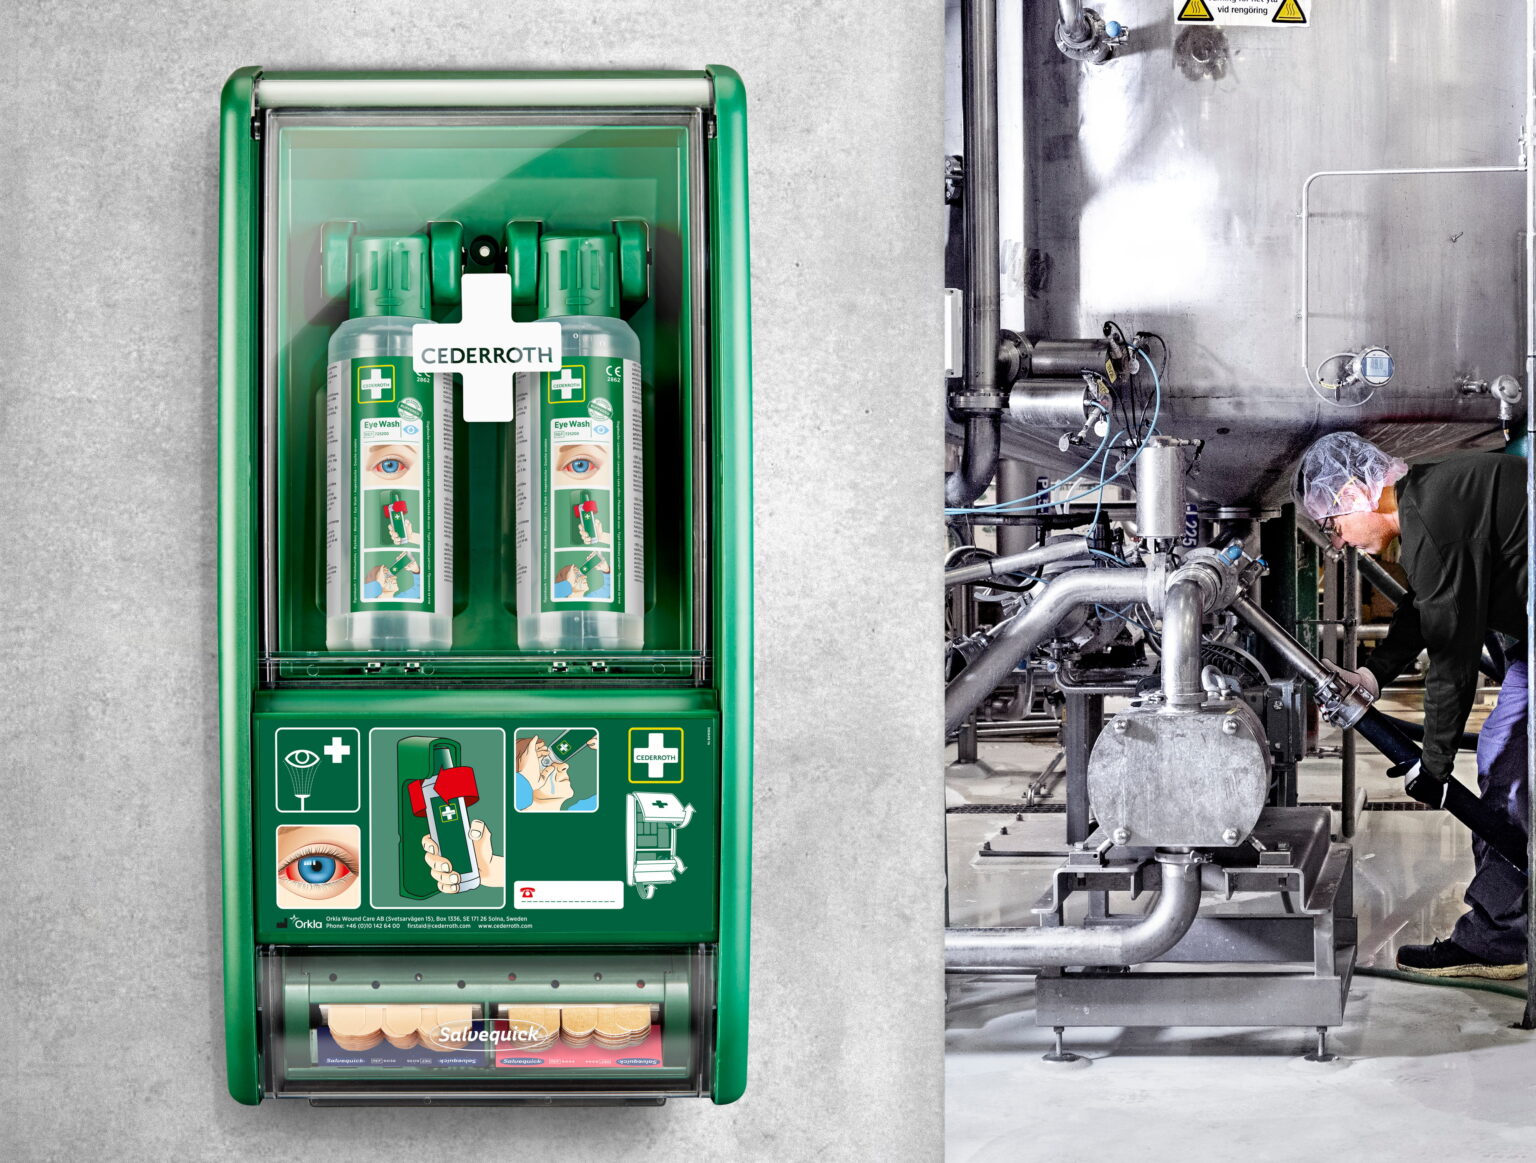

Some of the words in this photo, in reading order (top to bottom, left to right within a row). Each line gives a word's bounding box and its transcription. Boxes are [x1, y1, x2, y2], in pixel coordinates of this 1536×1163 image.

[1217, 6, 1229, 14] vid
[1231, 6, 1268, 15] rengöring
[421, 347, 553, 364] CEDERROTH
[364, 421, 378, 430] Eye
[379, 420, 400, 428] Wash
[554, 421, 568, 430] Eye
[569, 420, 590, 428] Wash
[294, 919, 323, 929] Orkla
[438, 1025, 540, 1045] Salvequick
